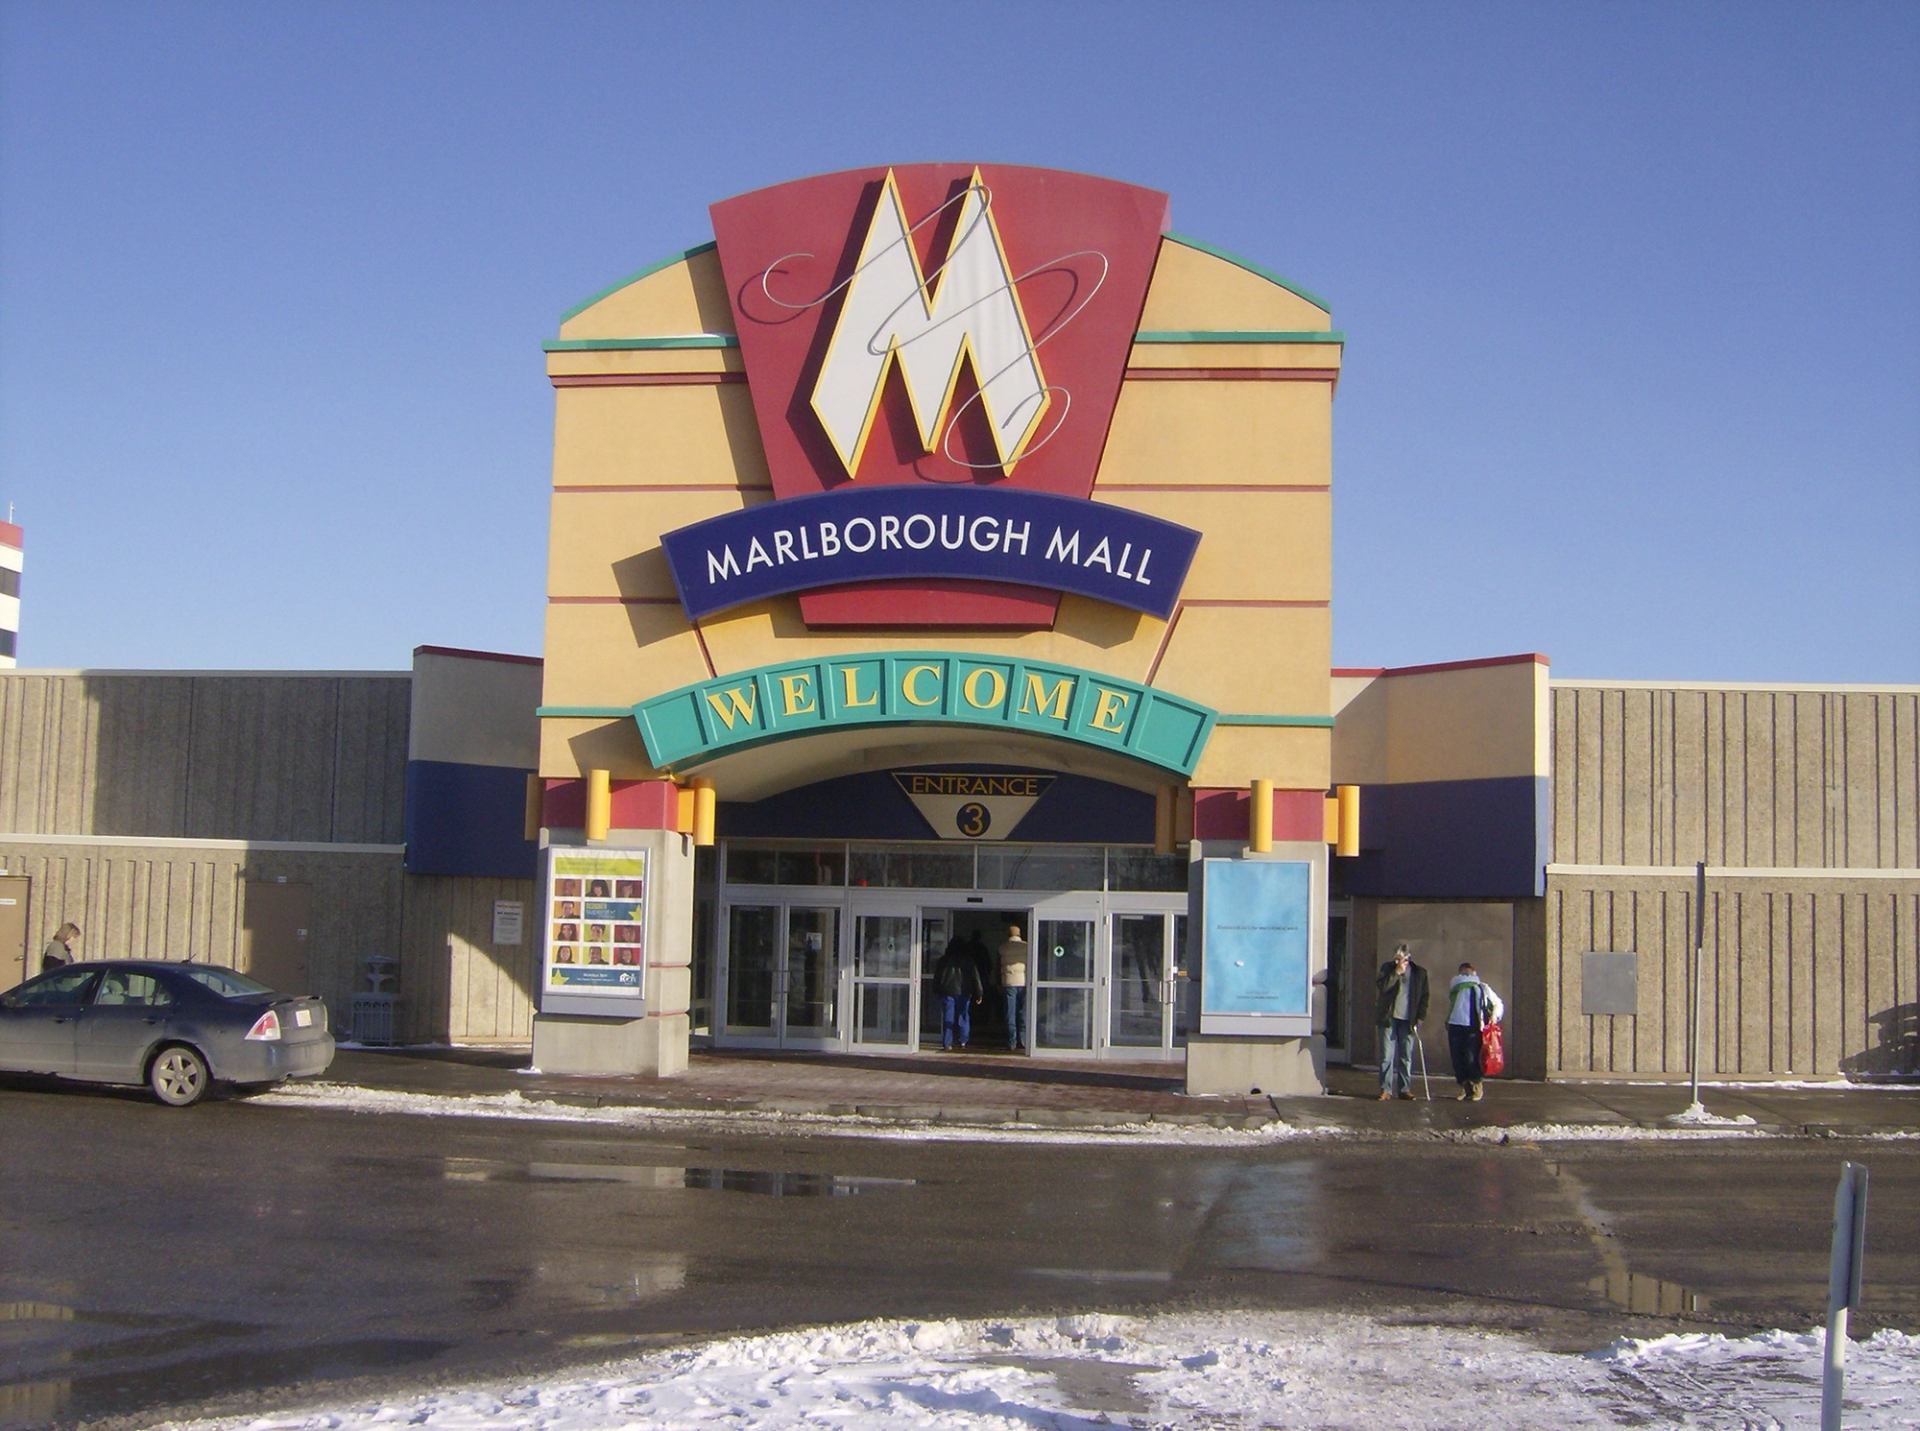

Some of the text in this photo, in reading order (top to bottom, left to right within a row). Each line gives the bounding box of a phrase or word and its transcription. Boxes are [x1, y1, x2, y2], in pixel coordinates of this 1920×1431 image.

[810, 165, 1051, 480] M
[707, 513, 1152, 586] MARLBOROUGH MALL
[707, 664, 1131, 734] WELCOME
[912, 776, 1038, 796] ENTRANCE
[964, 805, 985, 835] 3
